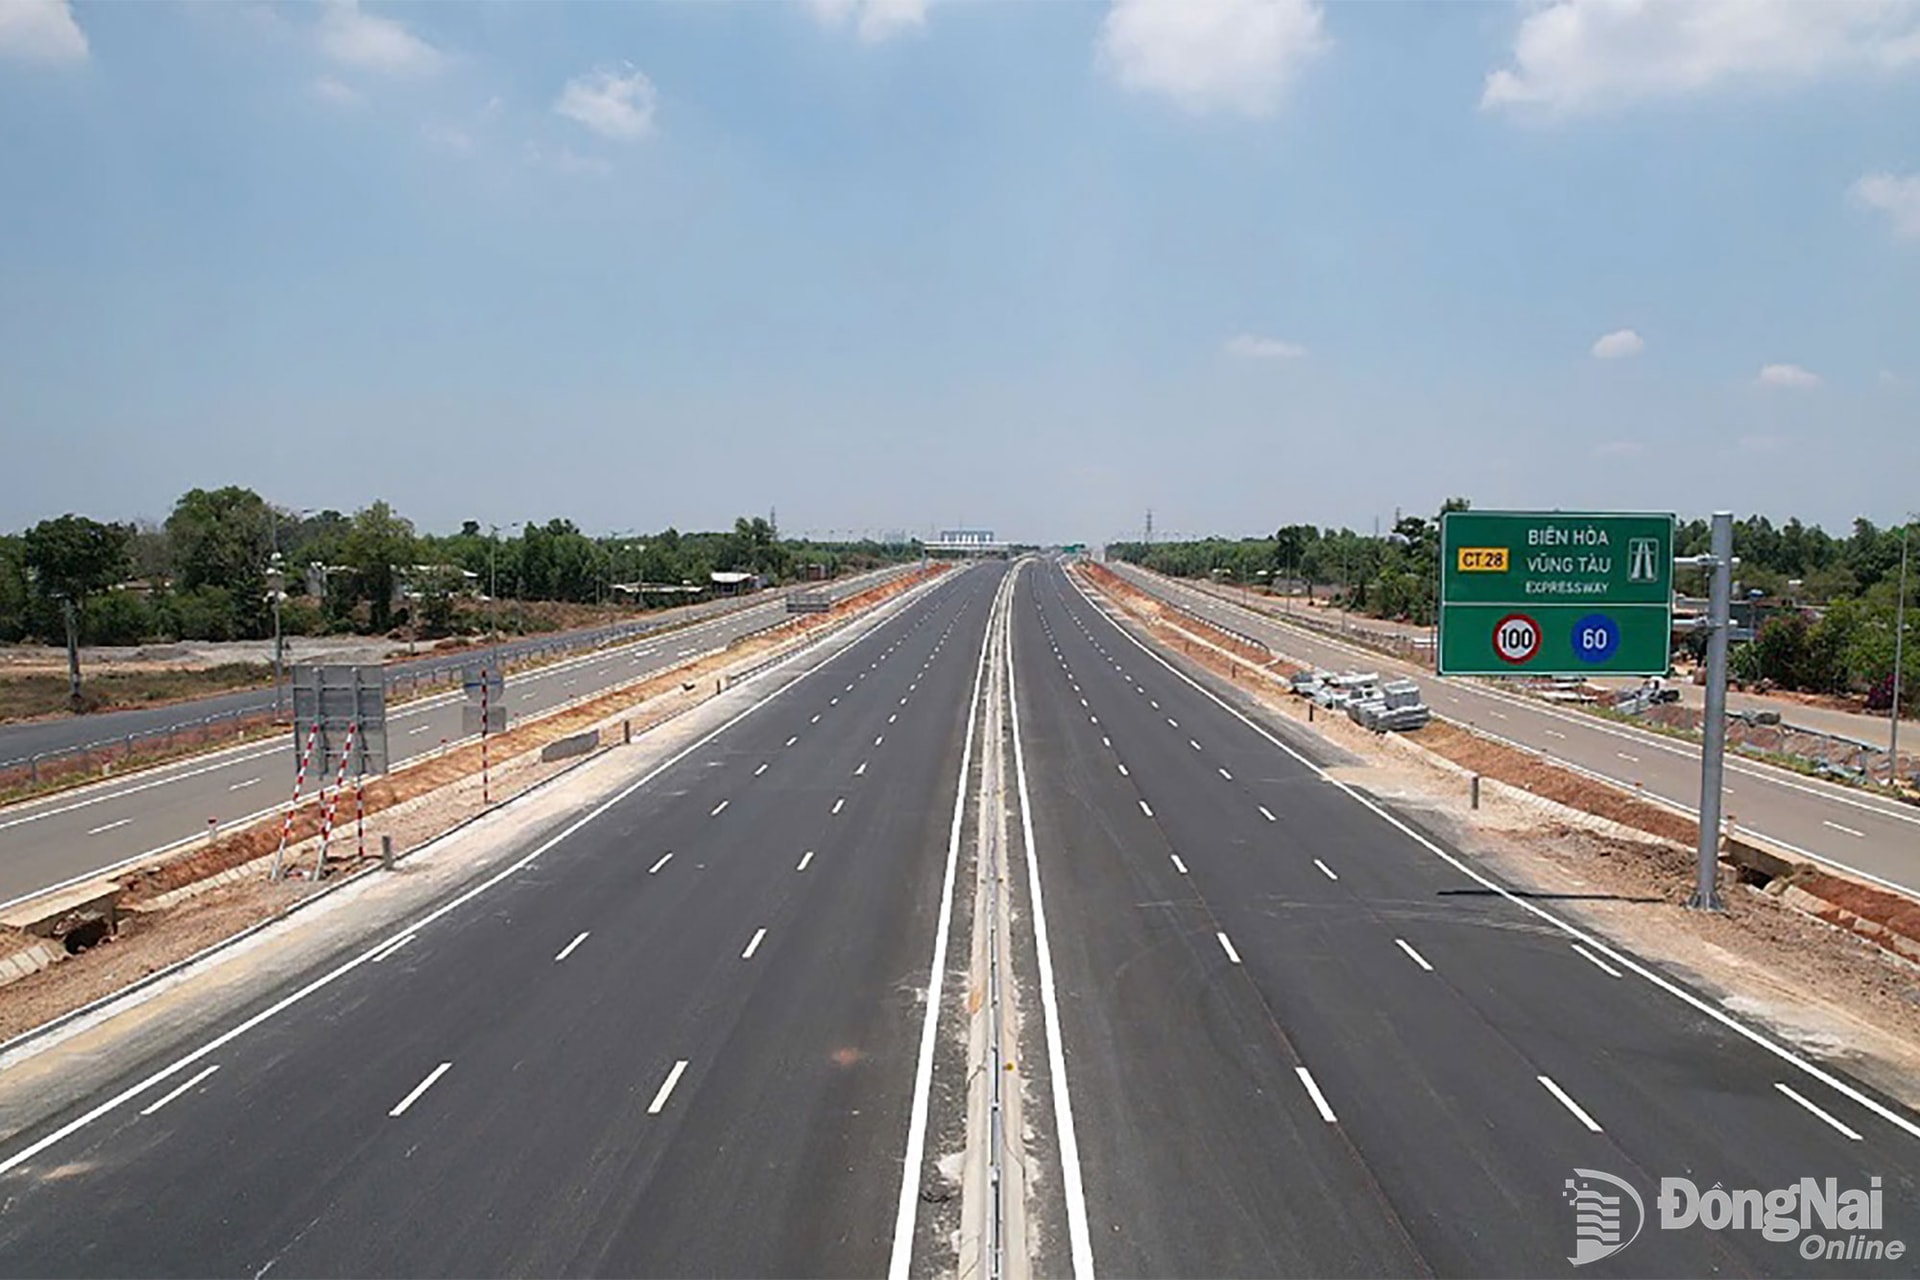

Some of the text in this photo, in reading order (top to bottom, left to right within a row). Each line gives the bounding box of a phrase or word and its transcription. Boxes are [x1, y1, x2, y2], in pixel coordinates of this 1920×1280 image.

[1528, 525, 1609, 545] BIÊN HÒA
[1526, 552, 1612, 573] VŨNG TÀU
[1525, 581, 1609, 594] EXPRESSWAY
[1501, 628, 1533, 649] 100
[1582, 629, 1608, 649] 60
